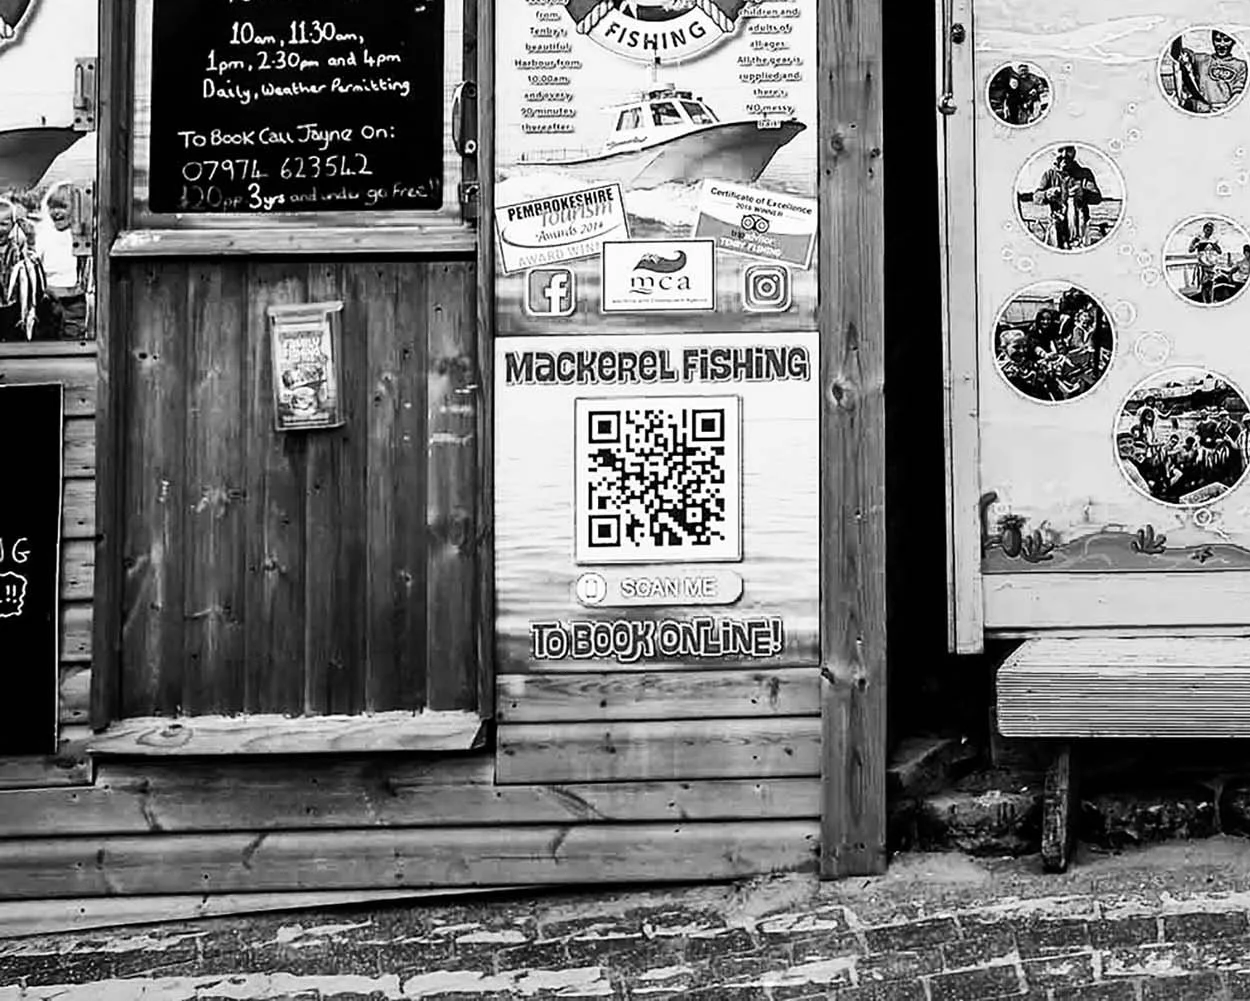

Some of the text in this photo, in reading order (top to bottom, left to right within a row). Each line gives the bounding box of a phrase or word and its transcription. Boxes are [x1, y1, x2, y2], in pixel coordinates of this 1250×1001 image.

[604, 20, 707, 51] FISHING
[327, 49, 357, 67] and
[363, 48, 402, 68] 4pm
[203, 78, 260, 104] Daily,
[331, 77, 411, 97] Permitting
[177, 130, 208, 148] To
[296, 123, 352, 151] Jayne
[361, 125, 396, 141] On:
[182, 153, 374, 182] 07974 623542
[247, 183, 286, 211] 3yrs
[507, 187, 615, 222] PEMBROKESHIRE
[630, 275, 691, 291] mca
[620, 576, 718, 599] SCAN ME
[570, 619, 656, 664] BOOK
